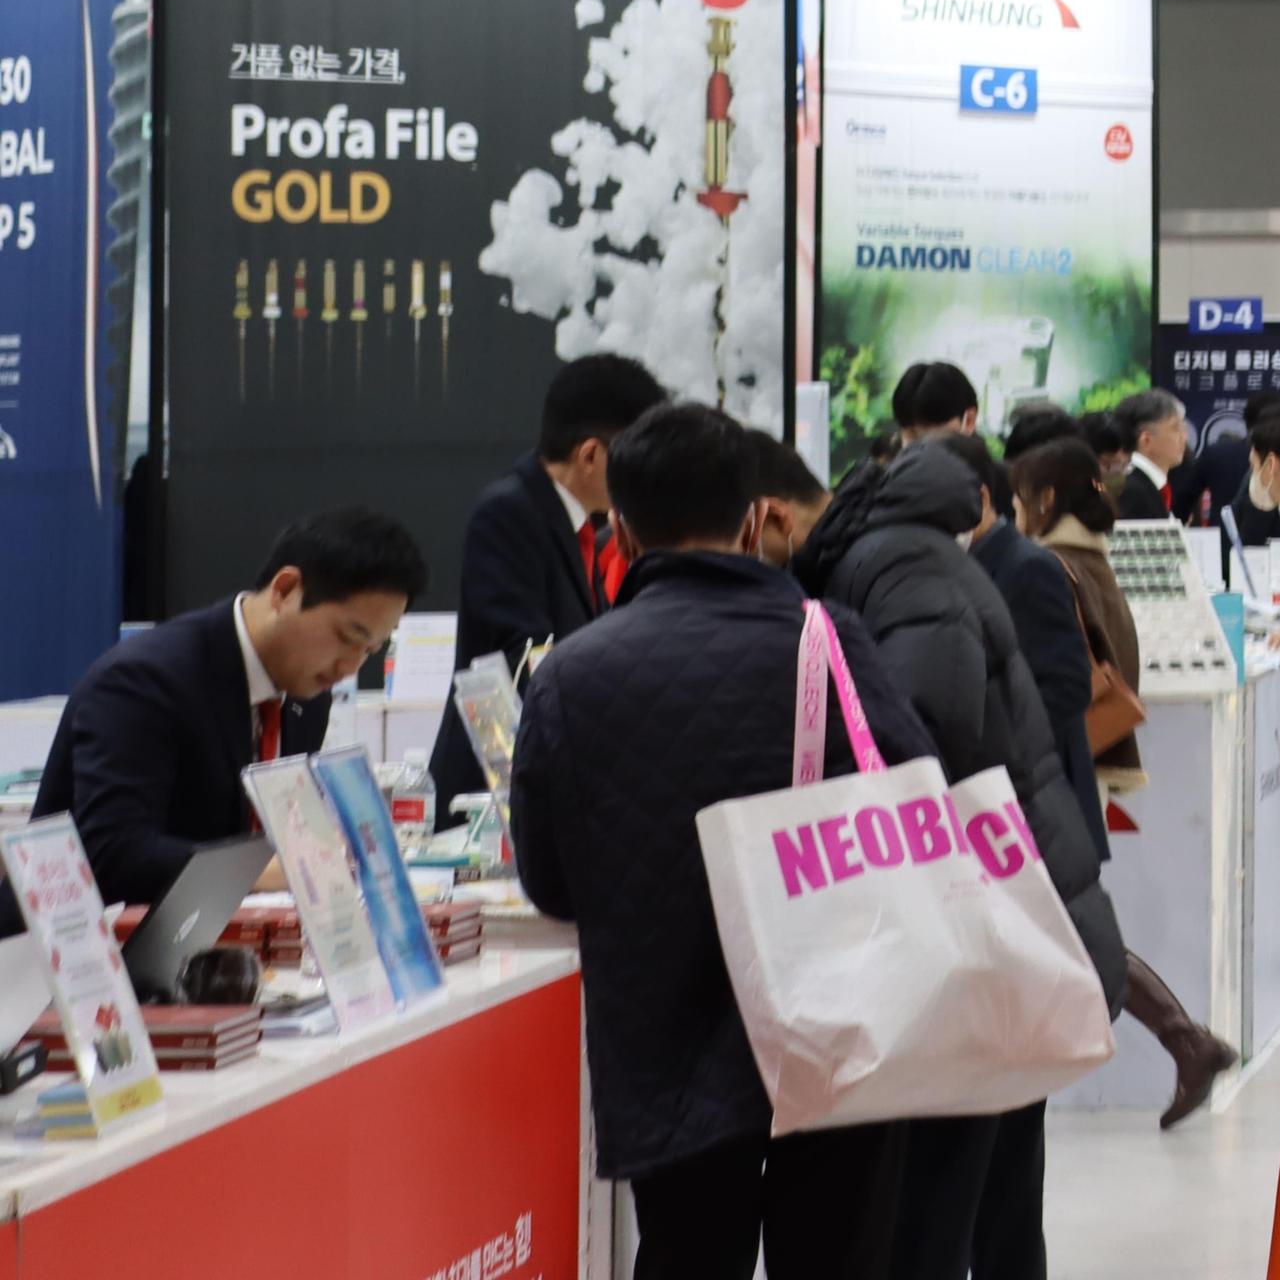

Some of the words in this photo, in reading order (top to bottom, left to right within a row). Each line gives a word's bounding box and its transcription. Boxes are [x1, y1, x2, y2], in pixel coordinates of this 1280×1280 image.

[230, 43, 283, 78] 거품
[288, 44, 341, 79] 없는
[970, 68, 1027, 109] C-6
[231, 104, 375, 160] Profa
[386, 108, 478, 162] File
[231, 169, 391, 224] GOLD
[857, 223, 910, 237] Variable
[856, 245, 971, 270] DAMON
[1198, 301, 1254, 331] D-4
